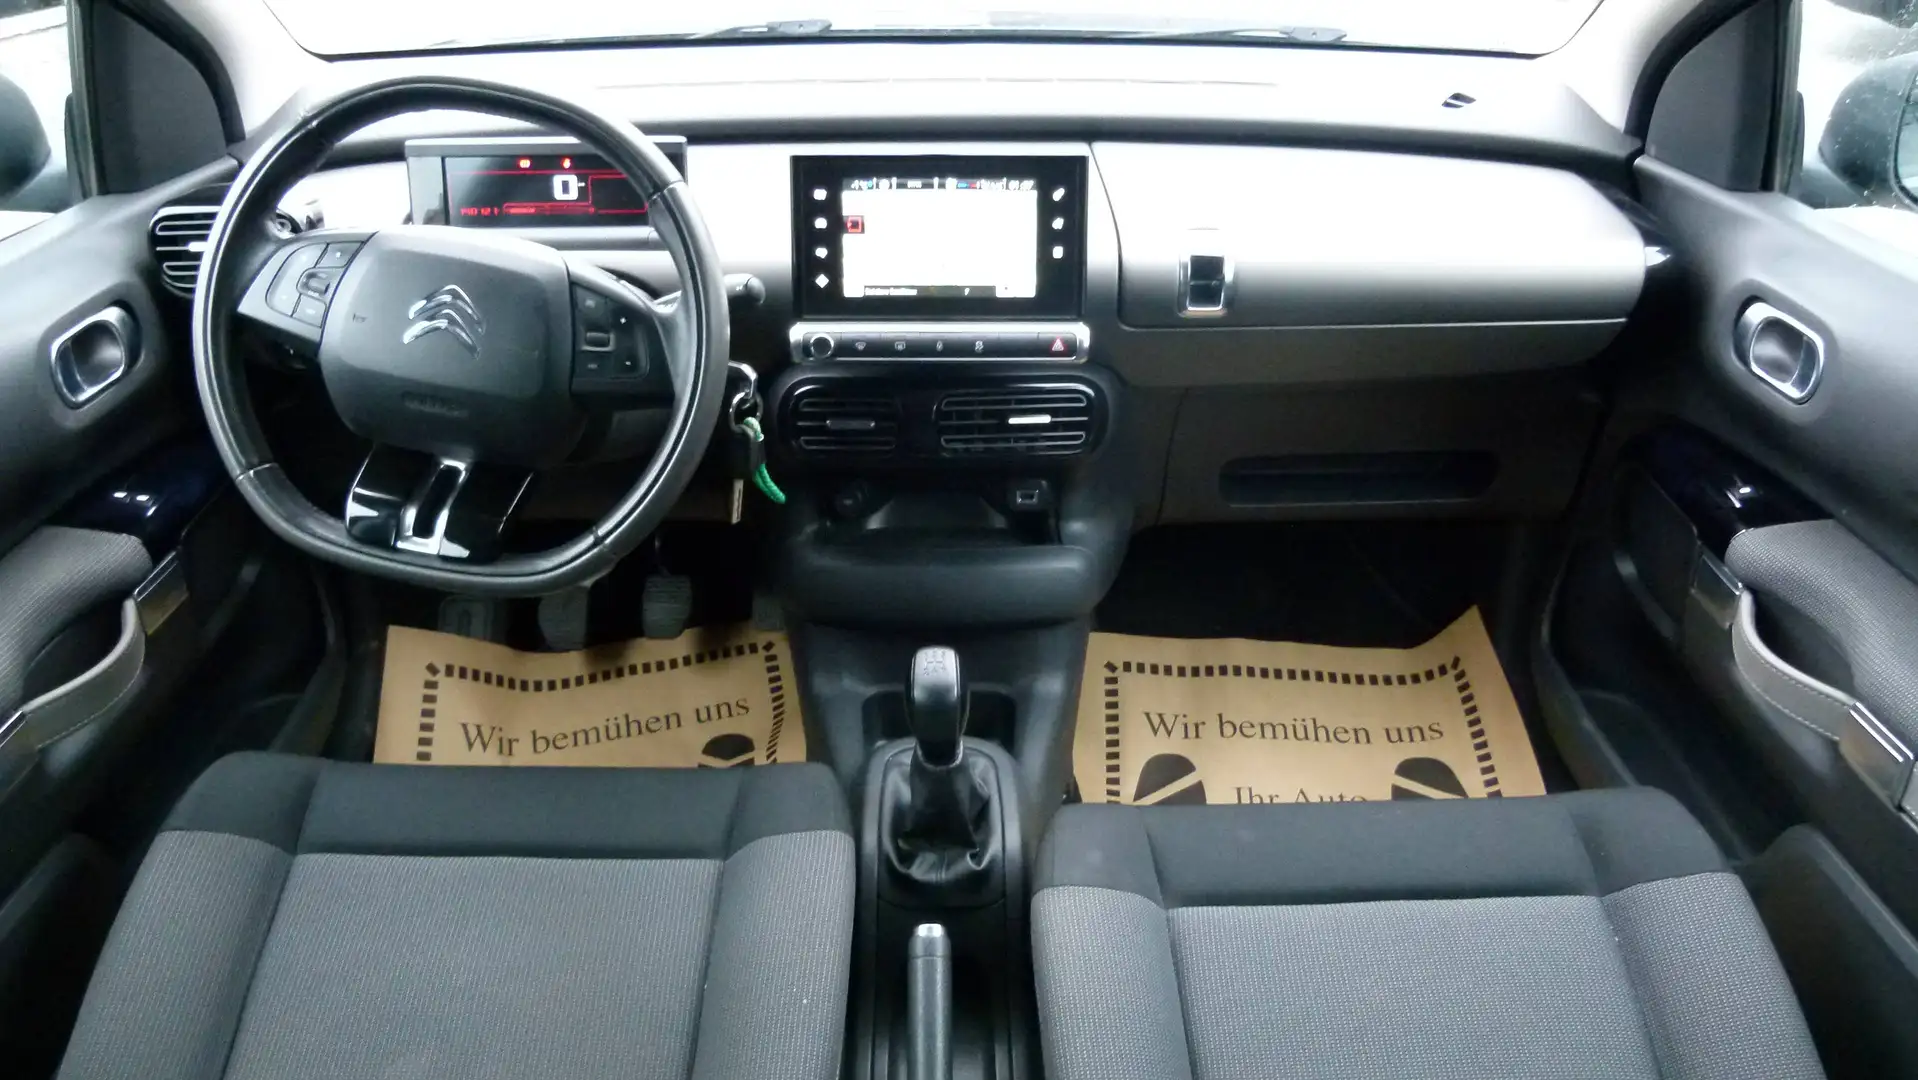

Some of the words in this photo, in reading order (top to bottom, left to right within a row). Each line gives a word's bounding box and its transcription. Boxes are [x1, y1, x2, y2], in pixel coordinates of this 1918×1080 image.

[553, 174, 578, 200] 0
[459, 722, 520, 756] Wir
[531, 712, 682, 754] bemühen
[695, 698, 750, 723] uns
[1142, 711, 1206, 740] Wir
[1216, 712, 1372, 744] bemühen
[1384, 722, 1444, 744] uns
